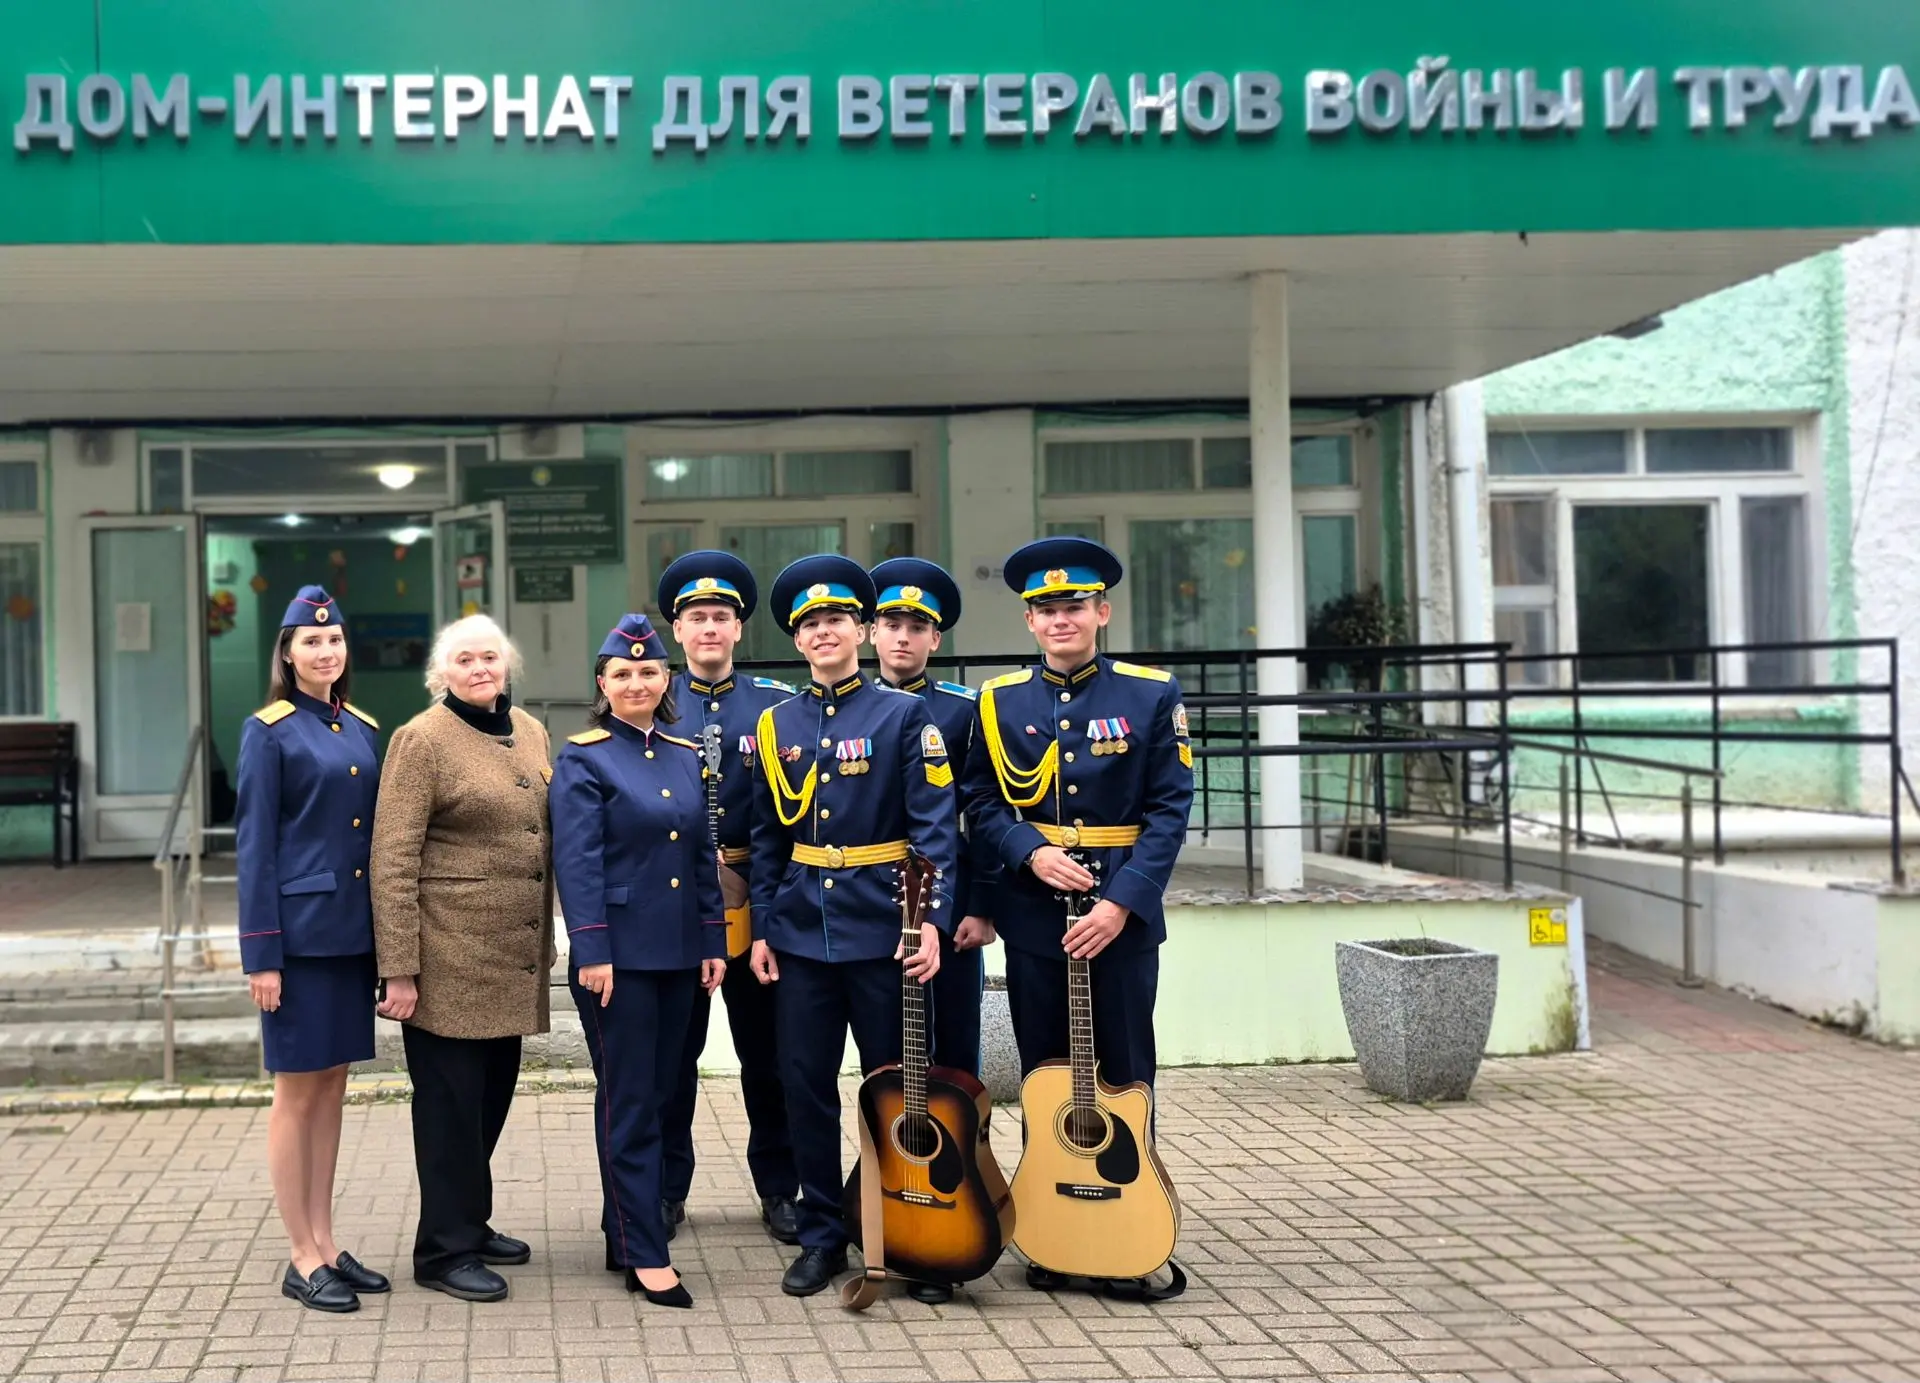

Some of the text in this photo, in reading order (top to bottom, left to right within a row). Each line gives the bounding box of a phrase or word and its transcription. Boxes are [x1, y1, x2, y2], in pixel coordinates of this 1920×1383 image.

[13, 55, 1920, 152] ДОМ-ИНТЕРНАТ ДЛЯ ВЕТЕРАНОВ ВОЙНЫ И ТРУДА
